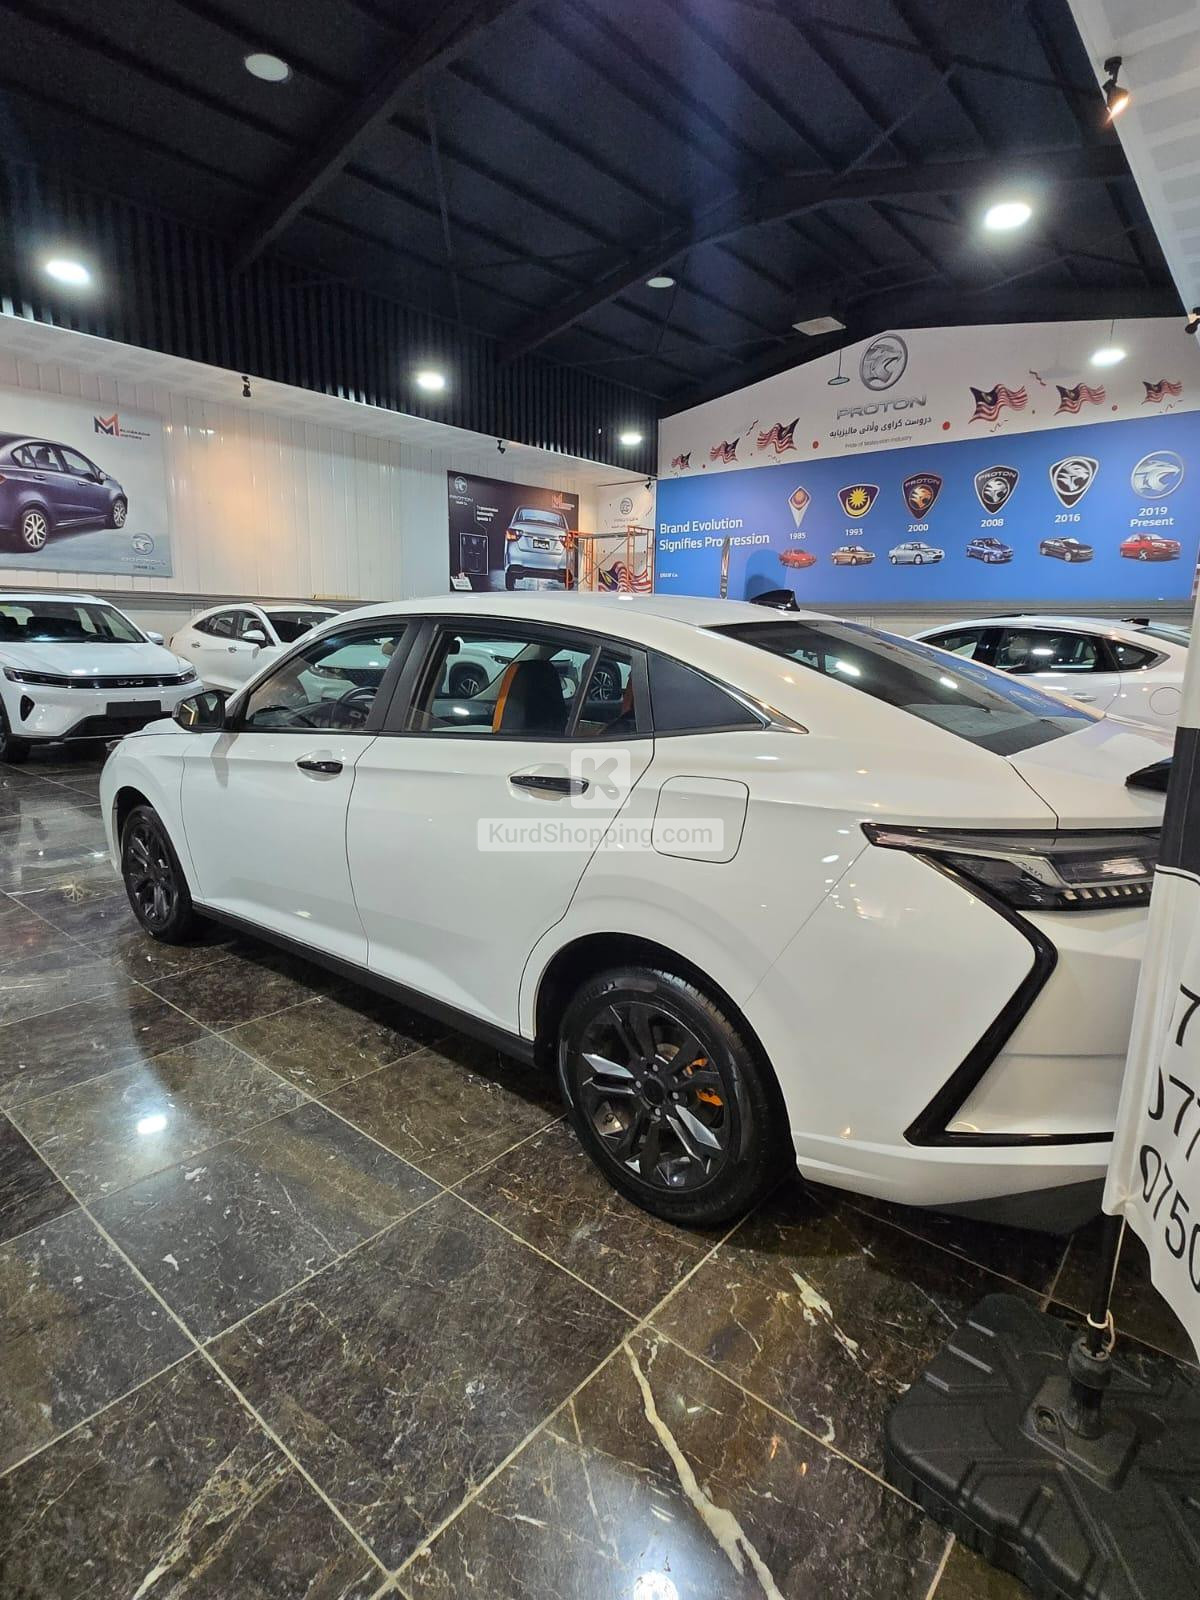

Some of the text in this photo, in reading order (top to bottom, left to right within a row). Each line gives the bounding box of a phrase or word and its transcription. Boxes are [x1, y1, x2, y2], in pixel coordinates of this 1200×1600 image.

[836, 394, 927, 420] PROTON
[977, 471, 1017, 482] PROTON
[904, 478, 940, 488] PROTON
[1138, 506, 1168, 517] 2019
[980, 518, 1004, 528] 2008
[1054, 513, 1080, 524] 2016
[1129, 516, 1174, 528] Present
[660, 517, 743, 534] Brand Evolution
[908, 523, 929, 532] 2000
[789, 532, 806, 540] 1985
[845, 528, 863, 536] 1993
[659, 532, 770, 553] Signifies Proression
